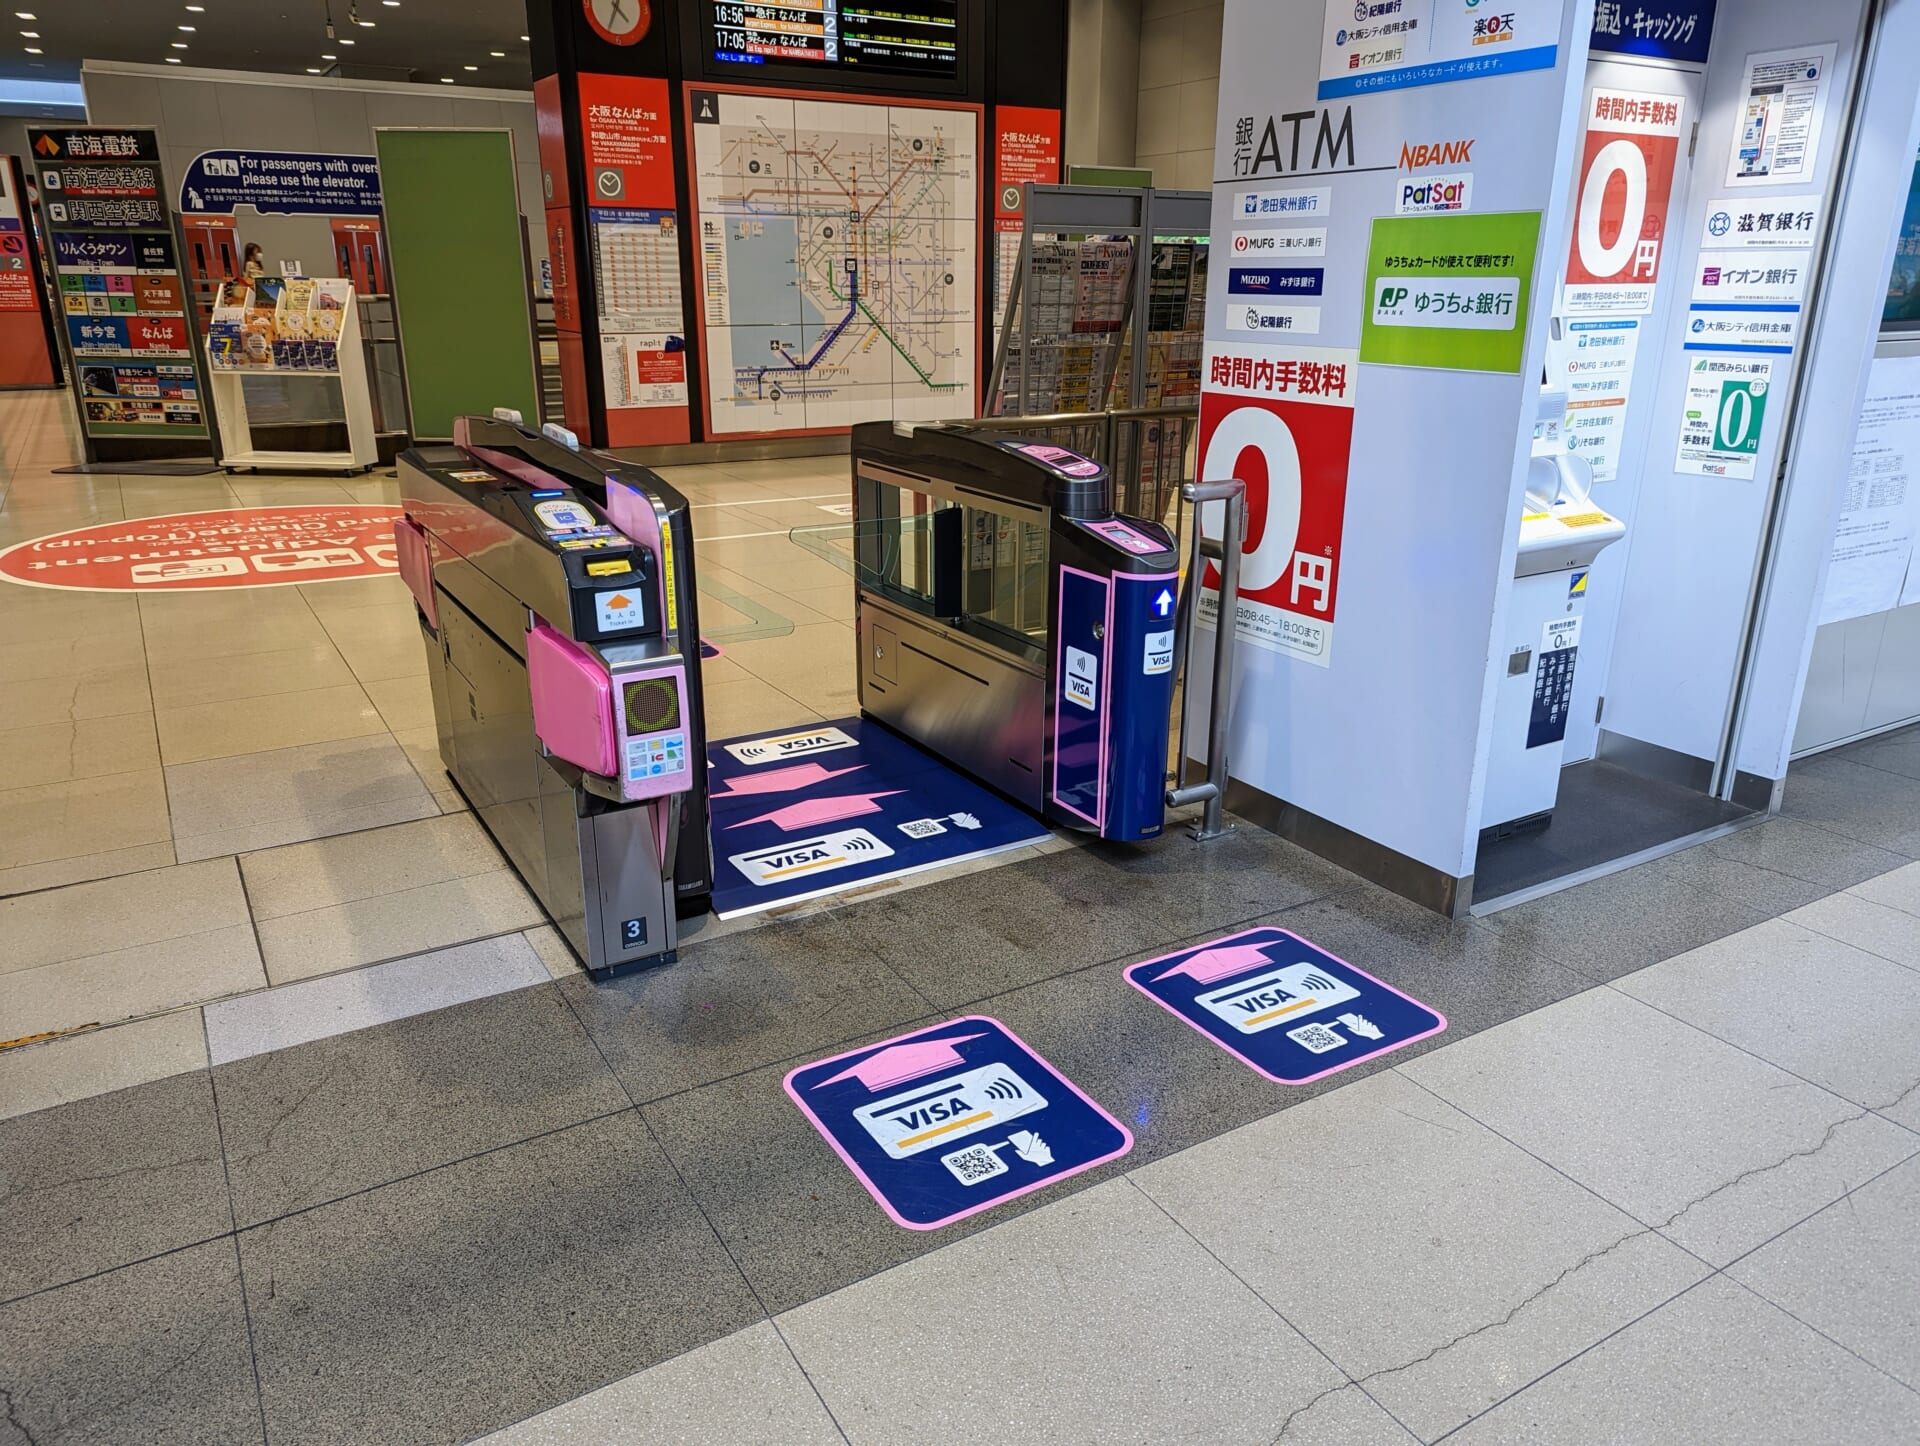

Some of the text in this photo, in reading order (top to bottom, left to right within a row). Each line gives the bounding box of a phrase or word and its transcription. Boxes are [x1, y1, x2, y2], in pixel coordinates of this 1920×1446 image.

[714, 4, 744, 24] 16:56
[756, 7, 776, 19] 急行
[779, 9, 806, 22] なんば
[825, 17, 836, 33] 2
[1592, 2, 1698, 43] 振込・キャッシング
[1347, 18, 1418, 41] 大阪シティ信用金庫
[716, 31, 745, 50] 17:05
[780, 35, 807, 48] なんば
[826, 42, 837, 57] 2
[1360, 48, 1403, 66] イオン銀行
[1595, 96, 1678, 126] 時間内手数料
[65, 135, 140, 156] 南海電鉄
[1233, 116, 1254, 176] 銀行
[1251, 105, 1355, 175] ATM
[239, 155, 258, 169] For
[261, 157, 322, 174] passengers
[324, 161, 349, 172] with
[1399, 139, 1475, 174] NBANK
[61, 168, 156, 189] 南海空港線
[242, 173, 368, 189] please use the elevator.
[1402, 181, 1464, 205] PatSat
[68, 200, 161, 222] 関西空港駅
[1260, 195, 1318, 213] 池田泉州銀行
[1737, 211, 1814, 233] 滋賀銀行
[59, 242, 128, 256] りんくうタウン
[1249, 237, 1322, 249] MUFG 三菱UFJ銀行
[11, 257, 22, 269] 2
[1240, 275, 1315, 287] MIZUHO みずほ銀行
[1722, 268, 1798, 285] イオン銀行
[1377, 308, 1405, 317] BANK
[1415, 291, 1513, 316] ゆうちょ銀行
[80, 325, 117, 339] 新今宮
[141, 327, 174, 340] なんば
[1705, 322, 1792, 334] 大阪シティ信用金庫
[220, 338, 232, 356] 7
[1579, 361, 1597, 370] MUFG
[1708, 362, 1769, 374] 関西みらい銀行
[1210, 355, 1347, 398] 時間内手数料
[1689, 421, 1709, 429] 時間内
[1578, 436, 1605, 447] りそな銀行
[1682, 434, 1711, 447] 手数料
[1702, 463, 1726, 475] PatSat
[27, 536, 357, 570] Adjustment
[1151, 655, 1170, 667] VISA
[1071, 680, 1090, 698] VISA
[779, 736, 831, 750] VISA
[760, 849, 831, 869] VISA
[627, 920, 640, 938] 3
[1228, 988, 1297, 1014] VISA
[888, 1097, 973, 1131] VISA
